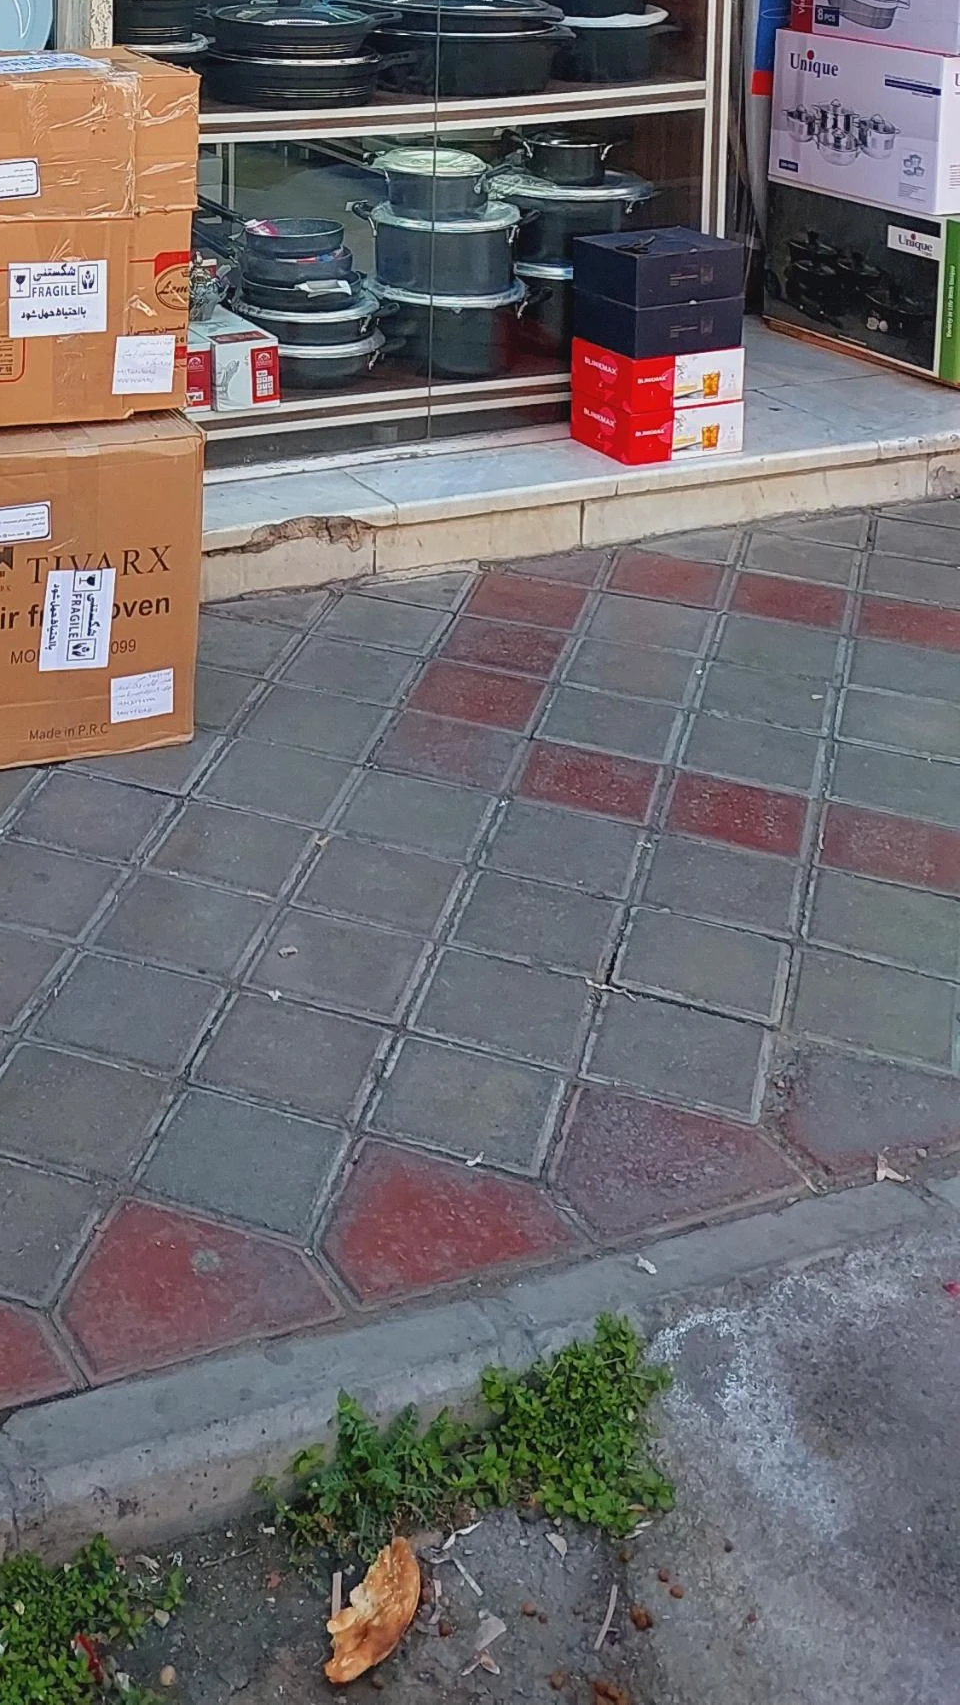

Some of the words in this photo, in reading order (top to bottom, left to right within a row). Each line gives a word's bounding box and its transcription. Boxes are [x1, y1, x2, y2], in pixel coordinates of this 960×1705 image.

[790, 50, 839, 78] Unique
[898, 232, 934, 251] Unique
[33, 263, 76, 282] شکستنی
[32, 284, 77, 298] FRAGILE
[159, 280, 189, 295] Lem
[21, 310, 37, 320] شود
[38, 309, 55, 320] حمل
[27, 546, 172, 584] TIVARX
[50, 583, 60, 600] شود
[49, 600, 60, 616] حمل
[68, 593, 82, 639] FRAGILE
[87, 593, 101, 637] شکستنی
[112, 596, 170, 621] oven
[29, 727, 61, 741] Made
[78, 722, 109, 736] P.R.C
